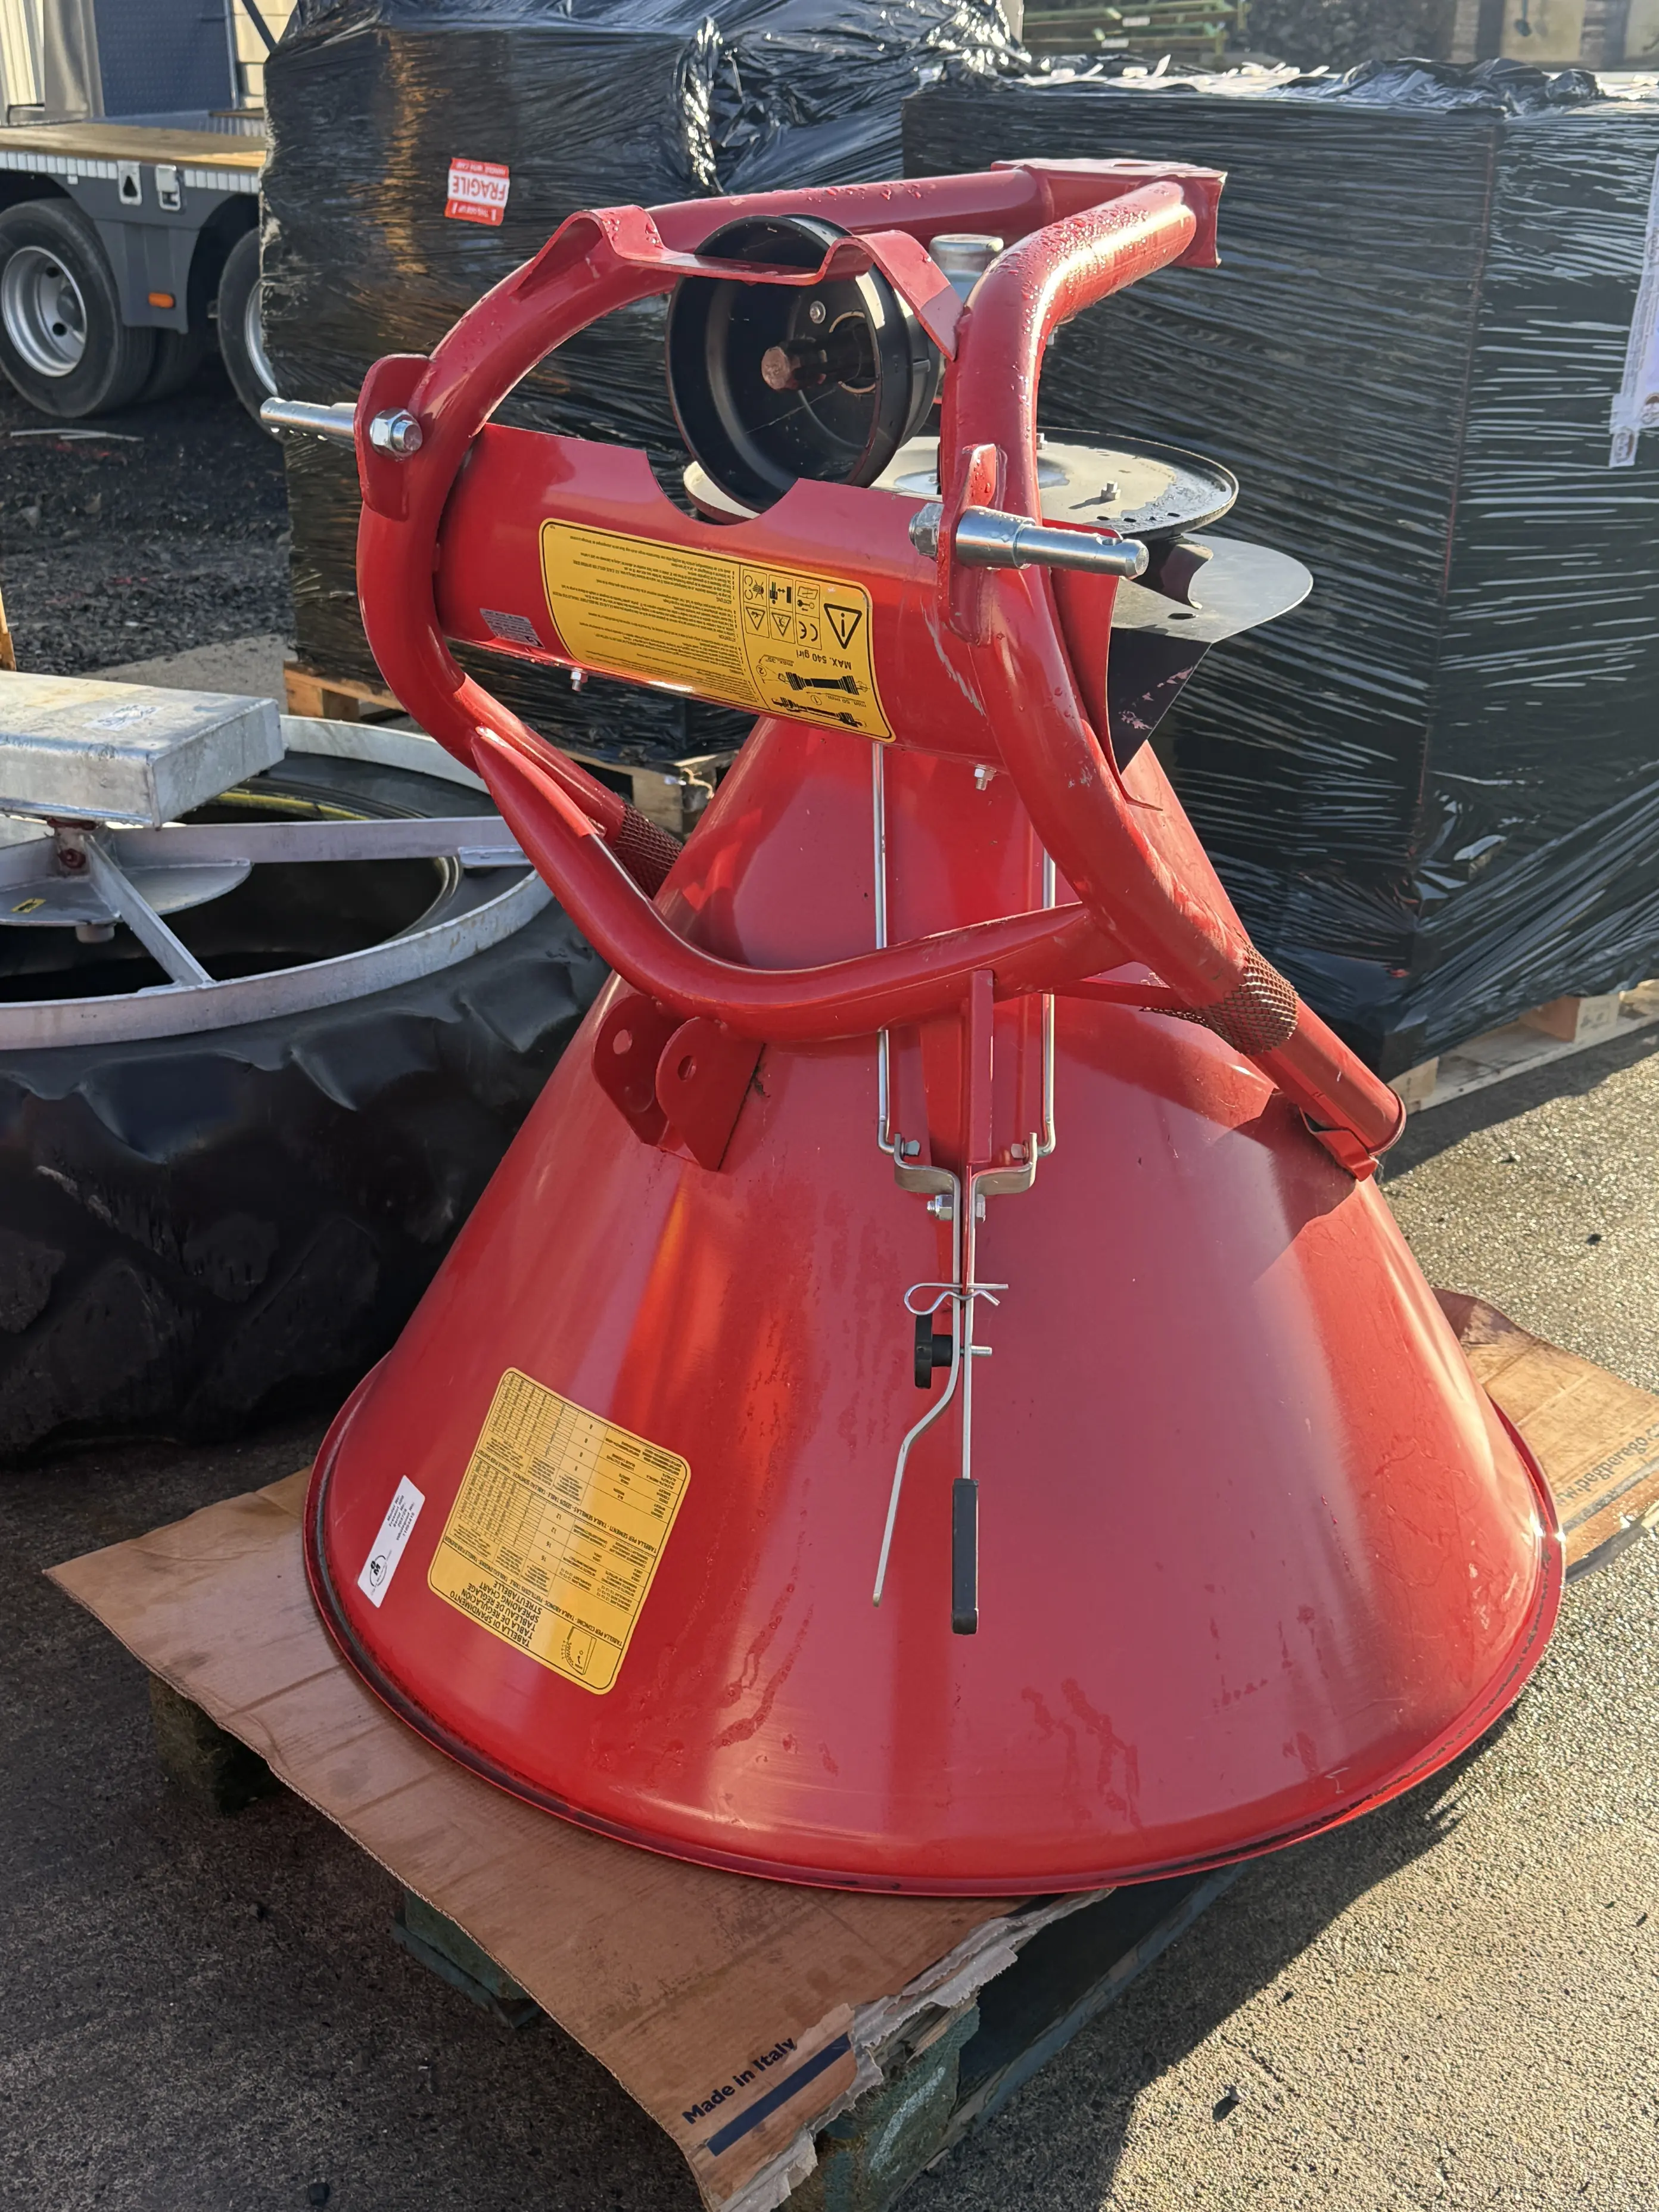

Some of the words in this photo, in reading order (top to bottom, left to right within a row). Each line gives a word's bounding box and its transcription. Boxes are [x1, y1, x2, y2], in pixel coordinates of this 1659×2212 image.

[453, 176, 506, 200] FRAGILE
[795, 648, 810, 660] giri
[811, 652, 827, 664] 540
[829, 657, 852, 670] MAX.
[593, 1517, 607, 1529] TABLA
[628, 1535, 637, 1544] PER
[637, 1539, 657, 1554] TABELLA
[478, 1581, 501, 1600] CHART
[492, 1579, 543, 1616] STREUTABELLE
[449, 1589, 493, 1623] SPANDIMENTO
[494, 1601, 505, 1611] DE
[500, 1594, 540, 1623] SPREADING
[500, 1614, 511, 1625] DE
[504, 1607, 536, 1631] TABLEAU
[561, 1609, 575, 1621] TABLA
[492, 1619, 501, 1629] DI
[510, 1620, 533, 1639] TABLA
[500, 1623, 531, 1647] TABELLA
[594, 1628, 603, 1637] PER
[603, 1633, 622, 1647] TABELLA
[682, 2086, 735, 2124] Made
[733, 2070, 755, 2087] in
[752, 2038, 797, 2071] Italy
